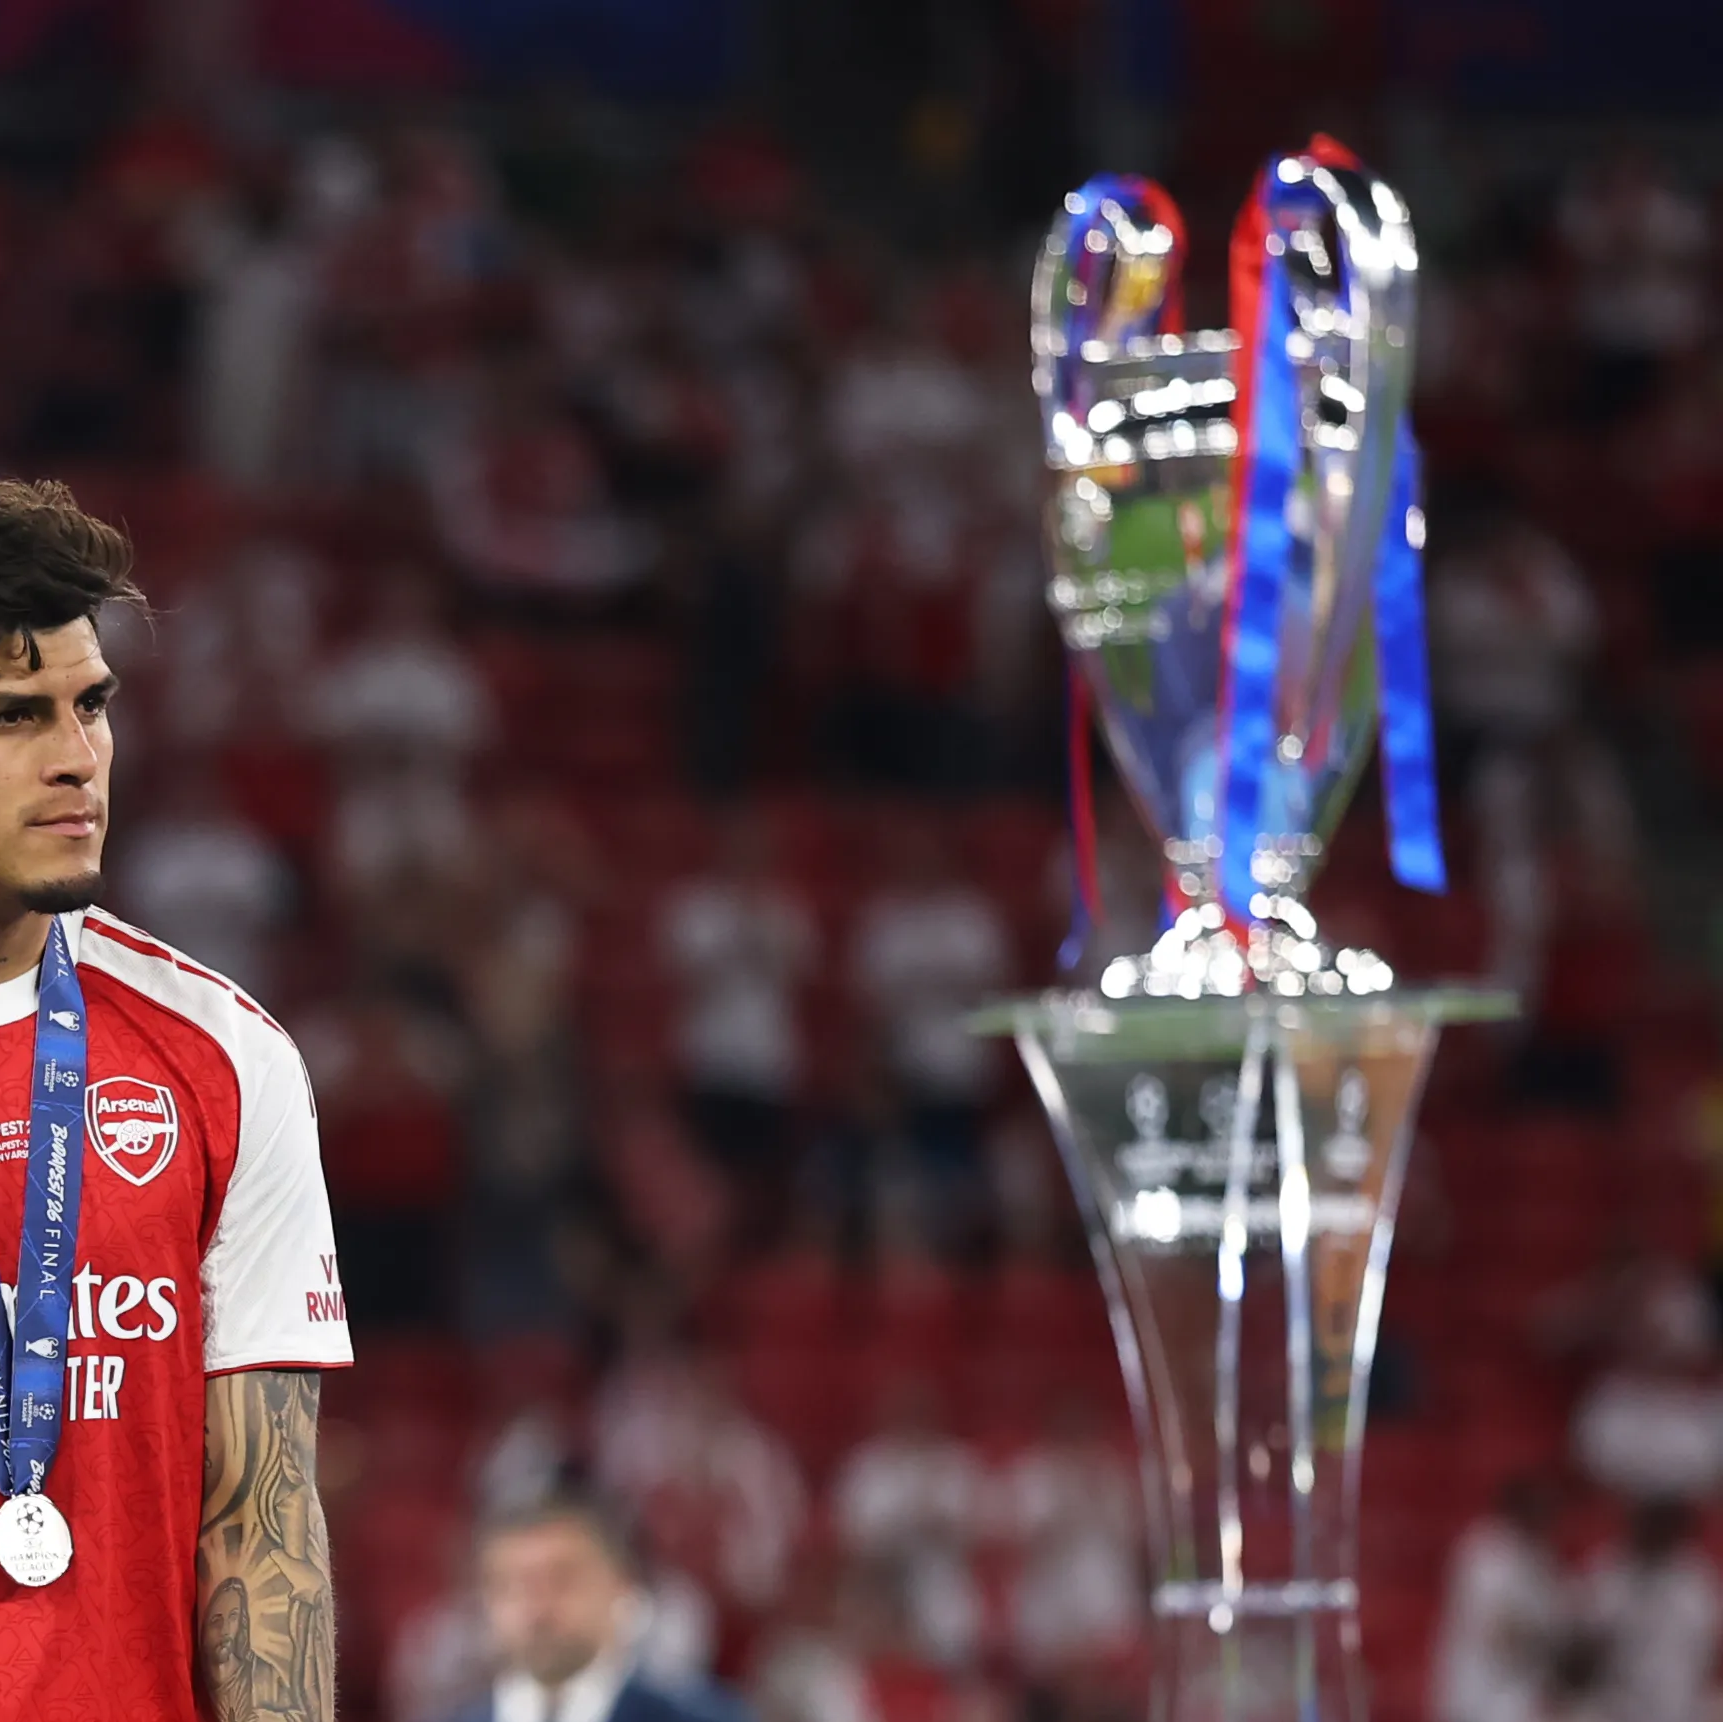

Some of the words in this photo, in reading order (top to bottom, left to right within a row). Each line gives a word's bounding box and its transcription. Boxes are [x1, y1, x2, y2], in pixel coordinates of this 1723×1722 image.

[97, 1097, 163, 1114] Arsenal
[46, 1198, 64, 1223] 26
[39, 1228, 61, 1300] FINAL
[67, 1355, 125, 1422] TER
